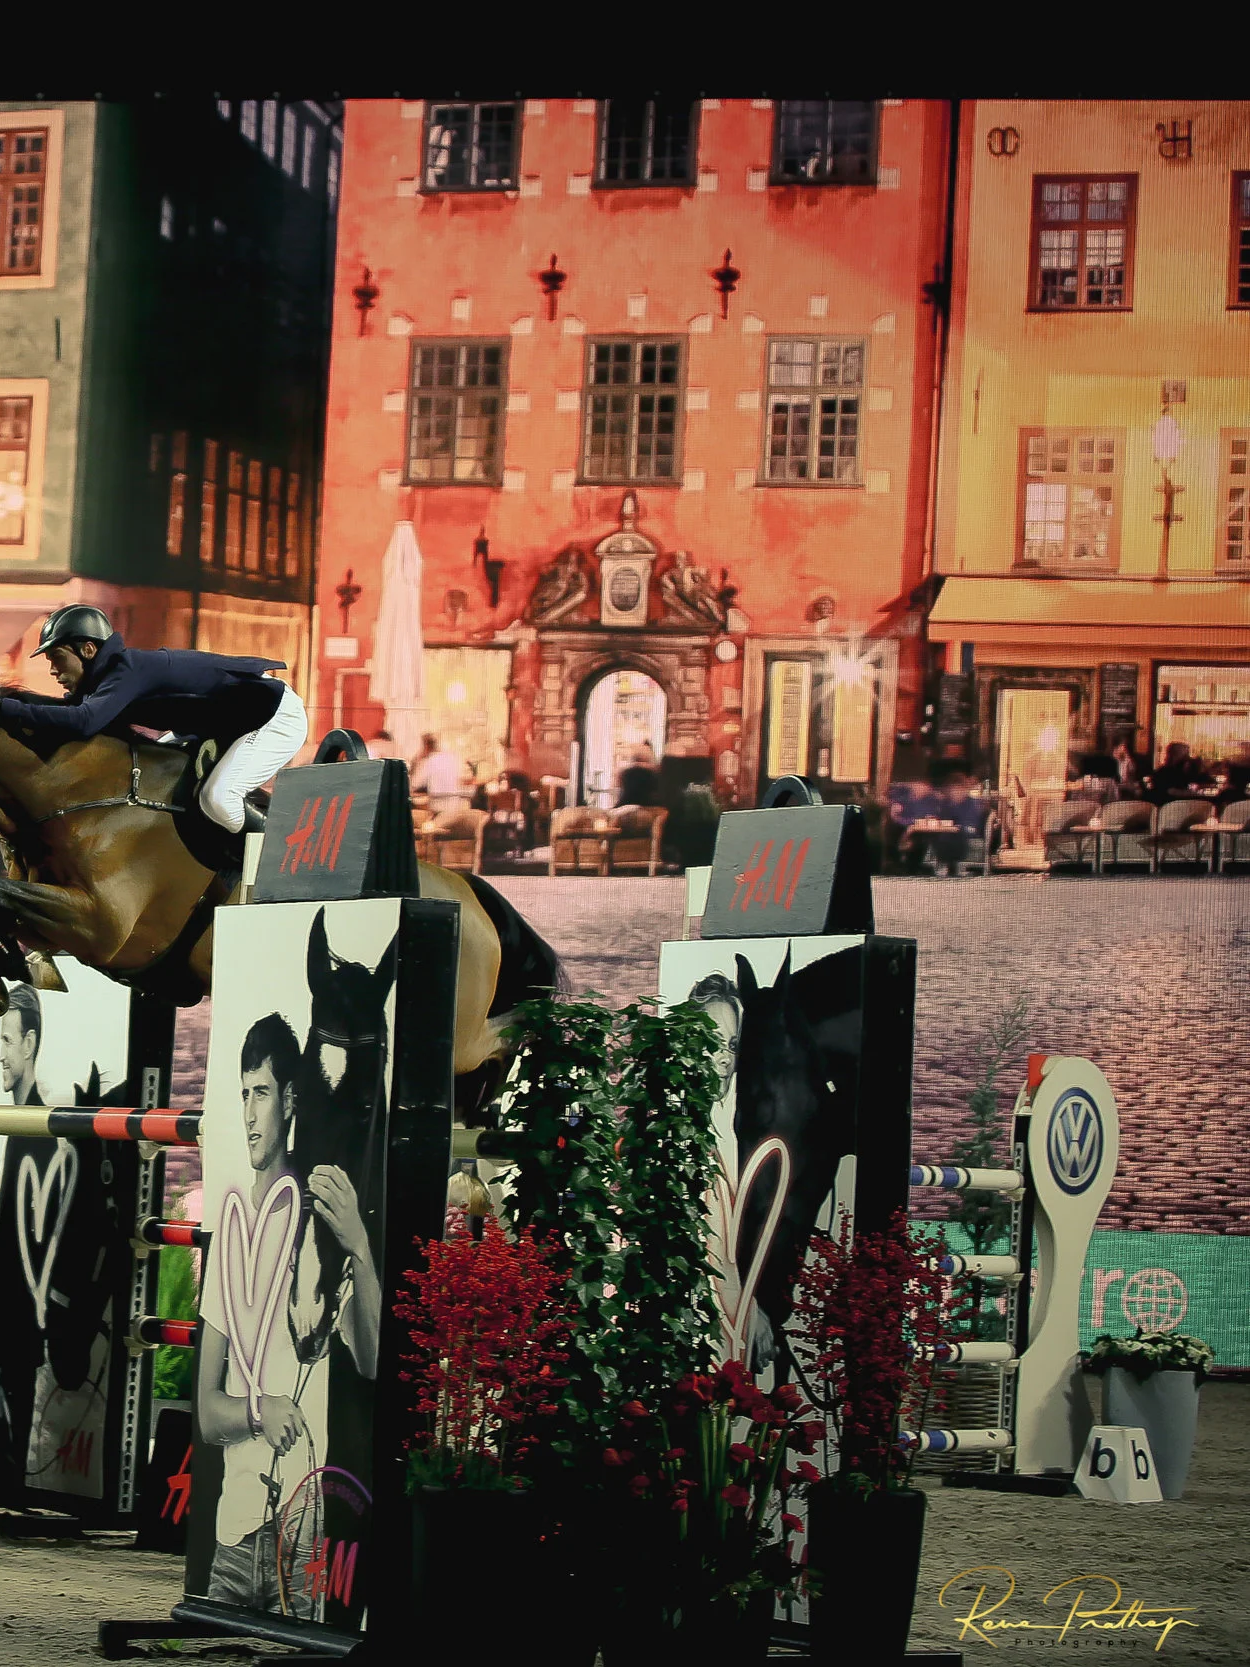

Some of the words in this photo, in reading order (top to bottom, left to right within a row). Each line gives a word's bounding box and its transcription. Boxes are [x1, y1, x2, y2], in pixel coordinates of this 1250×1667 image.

[280, 792, 356, 876] H&M
[729, 837, 812, 913] H&M
[1088, 1436, 1117, 1480] b
